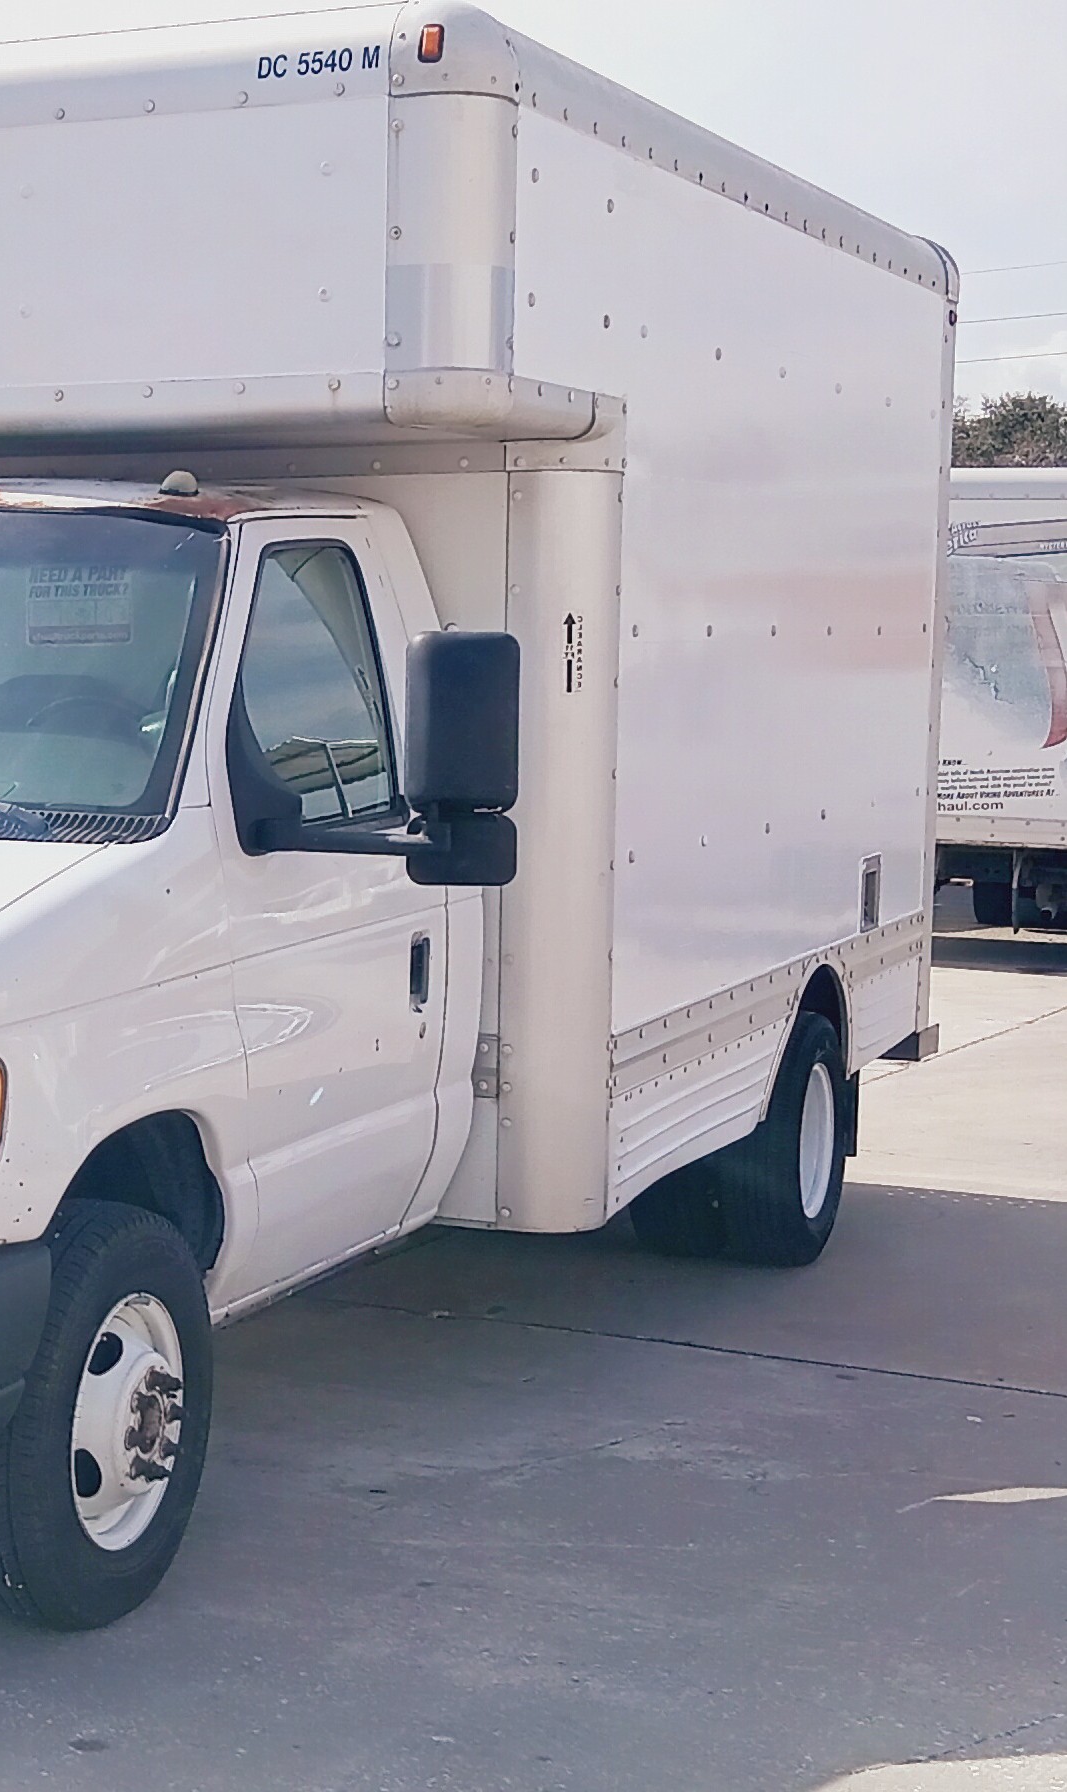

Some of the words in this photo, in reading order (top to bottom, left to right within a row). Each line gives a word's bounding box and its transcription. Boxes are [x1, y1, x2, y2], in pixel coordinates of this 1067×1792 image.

[257, 54, 288, 79] DC
[297, 47, 353, 76] 5540
[361, 45, 381, 69] M
[29, 567, 68, 583] NEED
[70, 567, 82, 582] A
[88, 566, 129, 581] PART
[29, 585, 52, 598] FOR
[54, 584, 81, 597] THIS
[83, 583, 129, 597] TRUCK?
[956, 791, 978, 799] ABOUT
[1003, 789, 1044, 798] ADVENTURES
[938, 799, 1004, 811] haul.com
